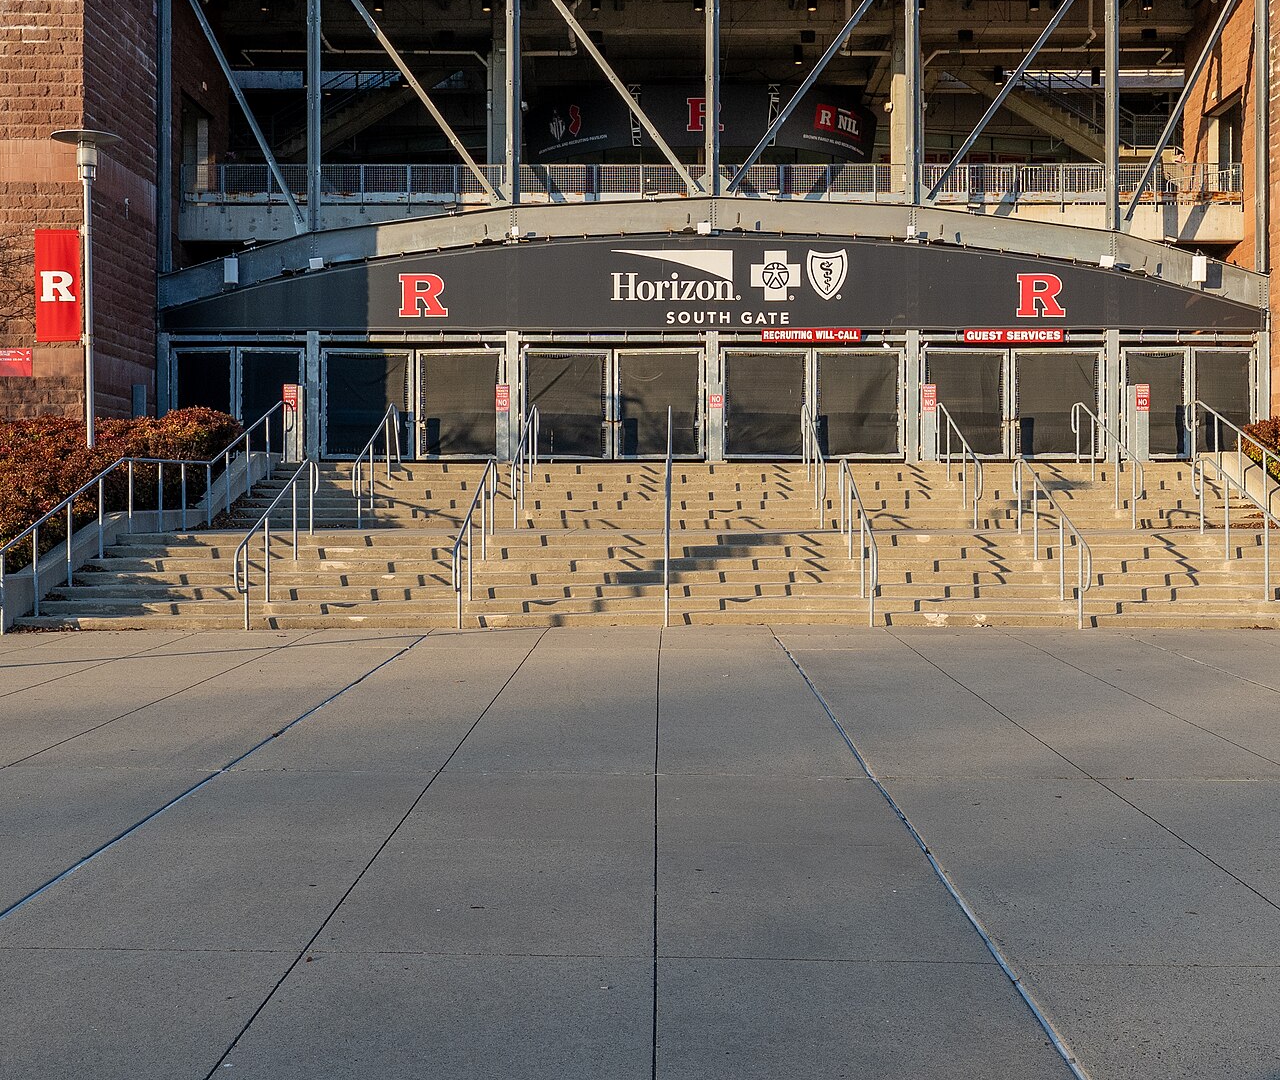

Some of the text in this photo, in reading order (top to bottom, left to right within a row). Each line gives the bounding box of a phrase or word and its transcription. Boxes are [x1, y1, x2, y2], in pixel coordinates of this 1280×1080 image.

[819, 109, 859, 135] R NIL
[40, 270, 76, 303] R
[398, 272, 449, 318] R
[610, 272, 736, 301] Horizon
[1016, 272, 1067, 318] R
[666, 311, 790, 325] SOUTH GATE
[763, 330, 859, 340] RECRUITING WILL-CALL
[966, 330, 1061, 341] GUEST SERVICES
